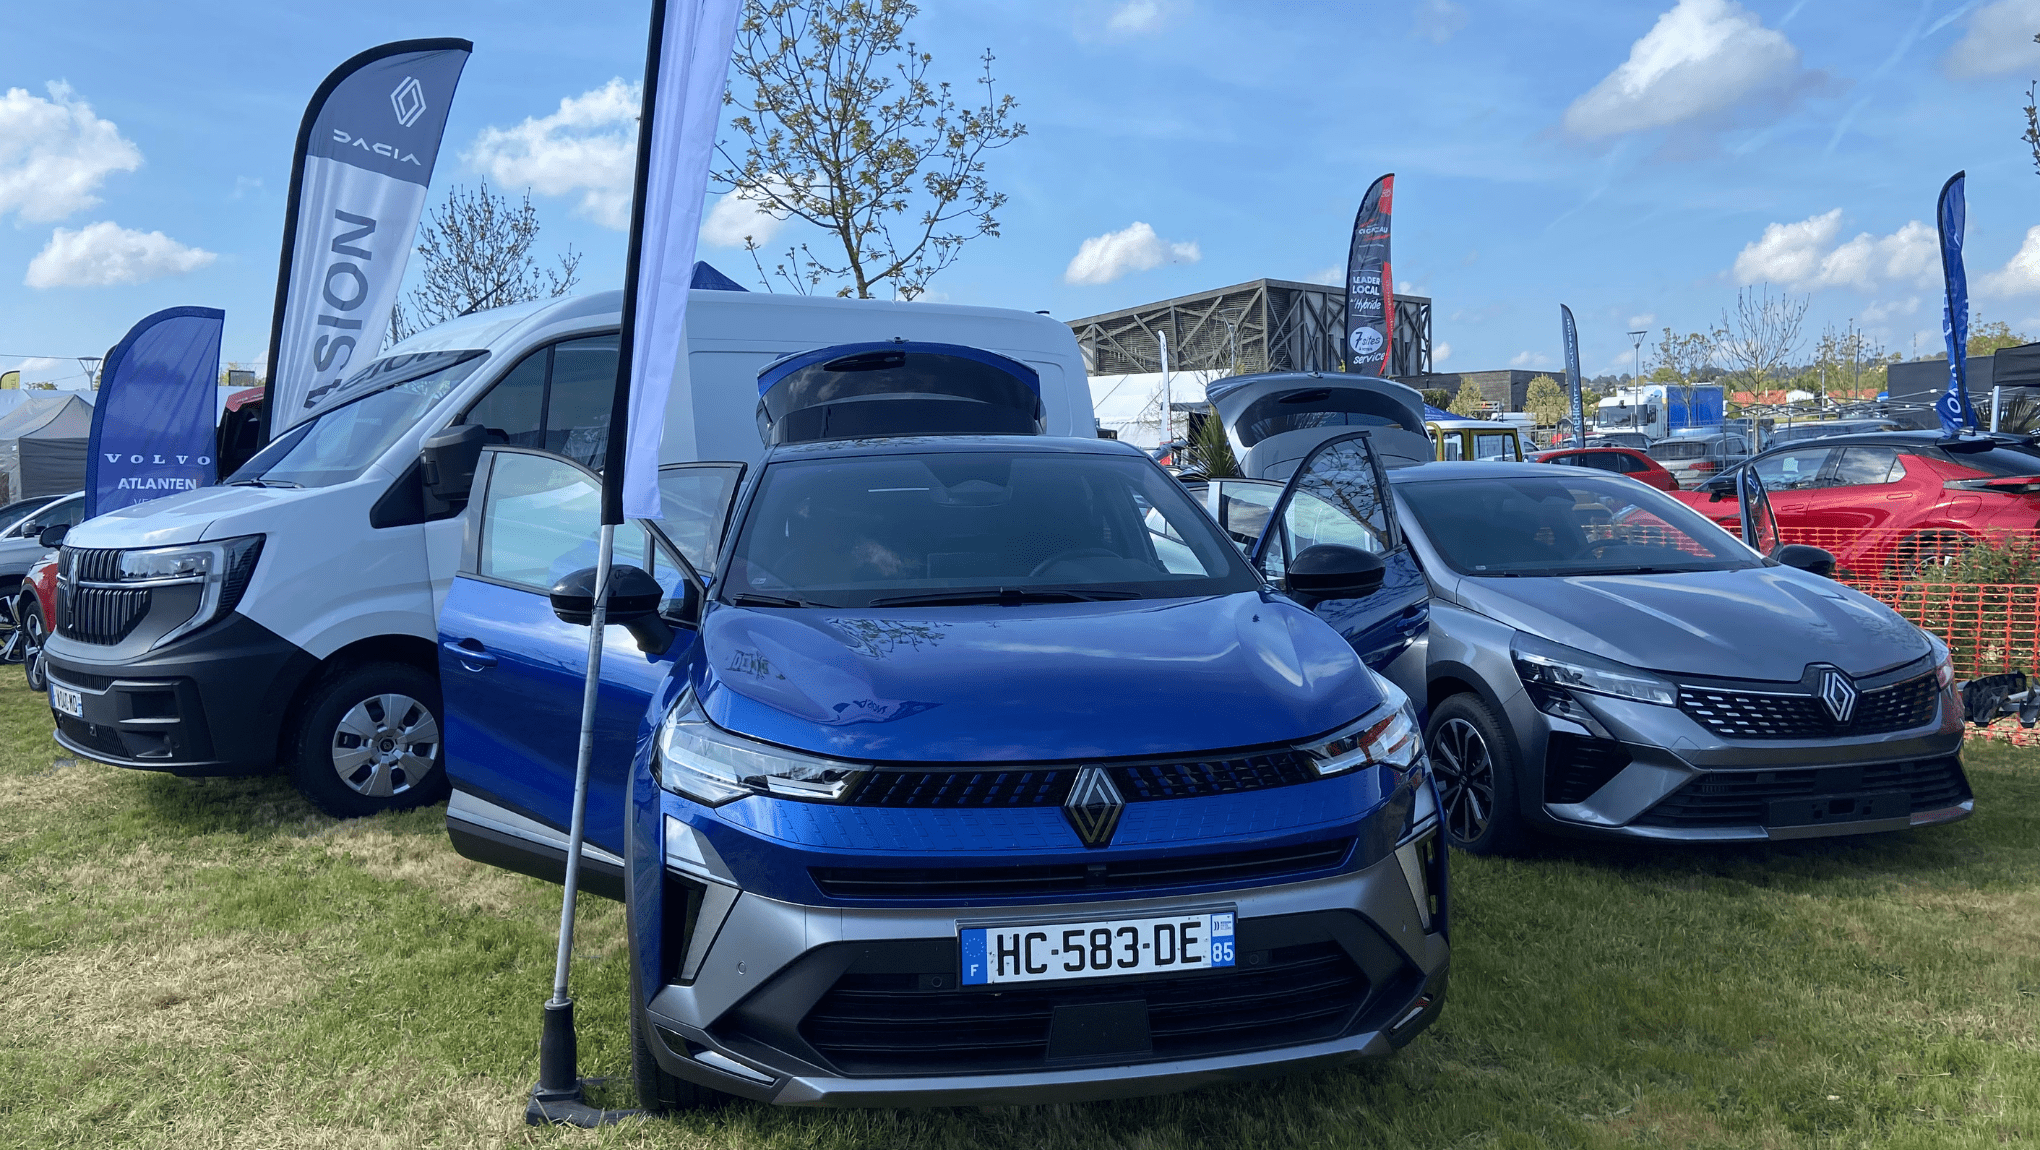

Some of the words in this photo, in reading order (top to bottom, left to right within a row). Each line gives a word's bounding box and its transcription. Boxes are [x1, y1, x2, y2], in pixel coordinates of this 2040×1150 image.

[333, 129, 421, 166] DACIA
[1352, 276, 1380, 285] LEADER
[1352, 285, 1380, 296] LOCAL
[1355, 331, 1363, 348] 7
[1362, 335, 1381, 346] sites
[1353, 352, 1385, 364] service
[104, 453, 211, 466] VOLVO
[117, 477, 198, 490] ATLANTEN
[997, 921, 1203, 977] HC-583-DE
[1212, 941, 1234, 963] 85
[970, 963, 979, 977] F
